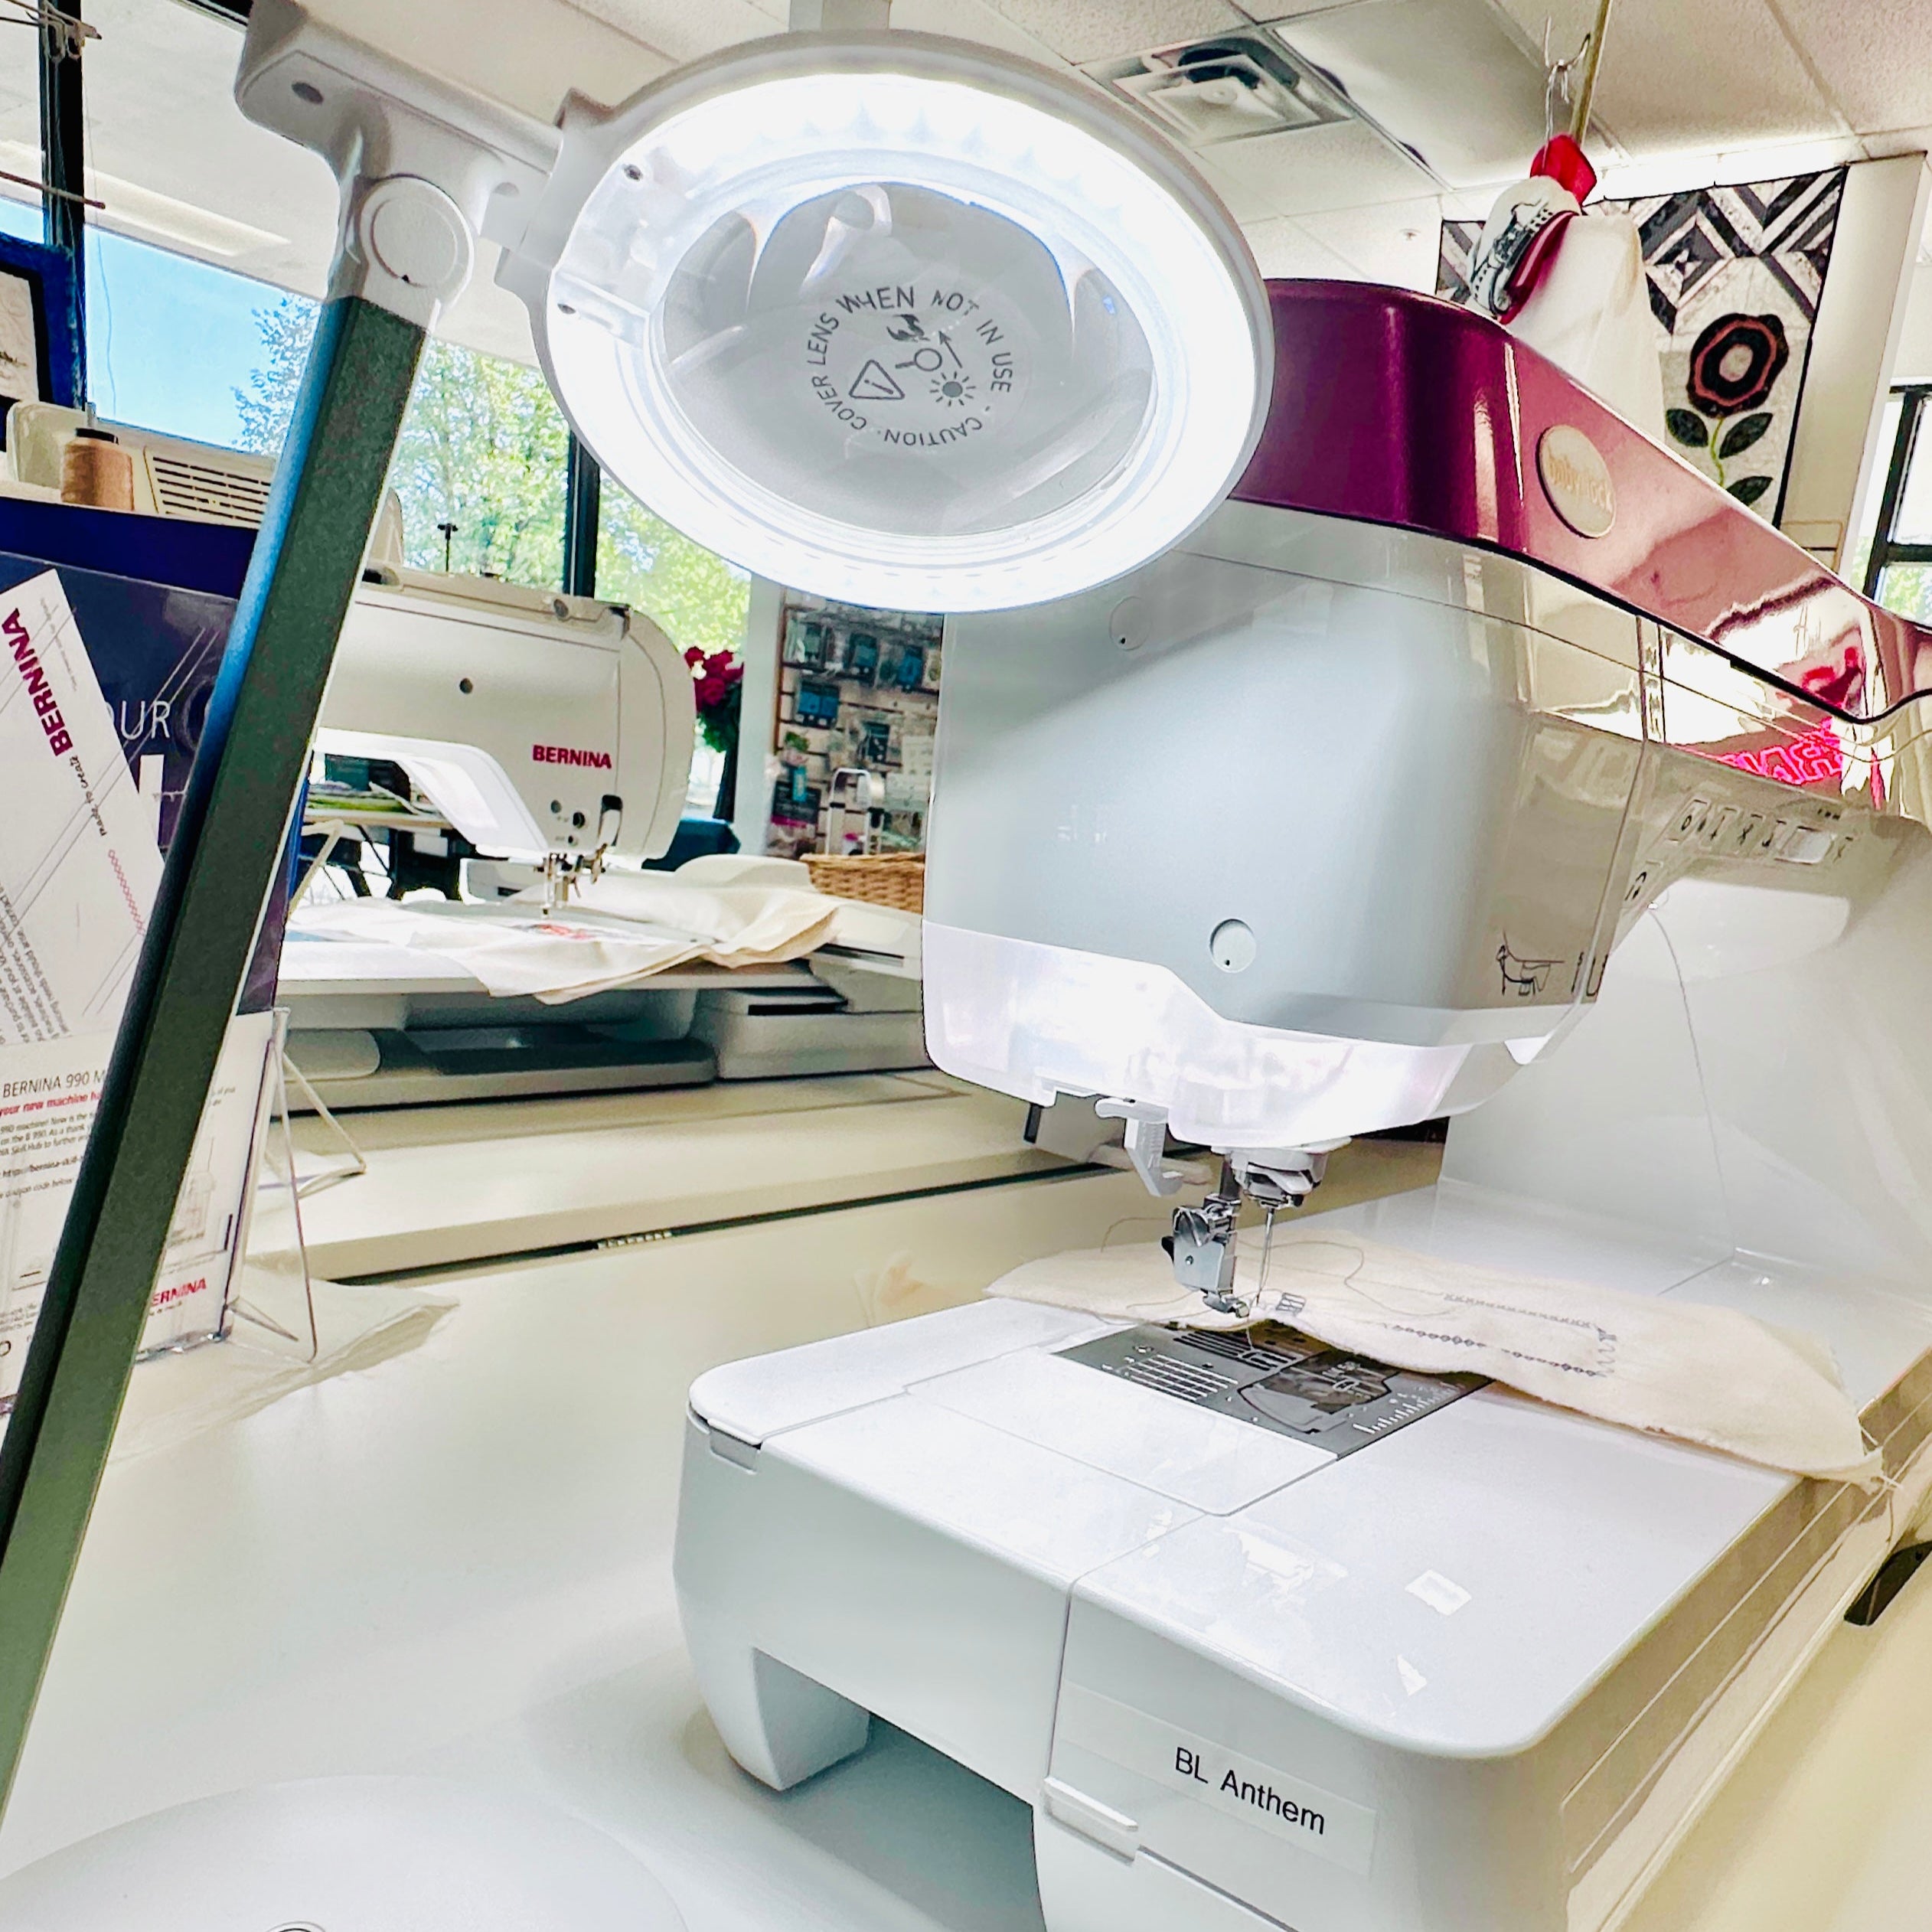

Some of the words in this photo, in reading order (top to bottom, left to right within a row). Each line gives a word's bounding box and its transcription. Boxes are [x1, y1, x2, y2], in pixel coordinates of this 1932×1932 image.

[836, 286, 914, 314] WHEN
[932, 289, 979, 316] NOT
[808, 312, 839, 365] LENS
[976, 319, 1004, 345] IN
[990, 352, 1013, 393] USE
[811, 375, 867, 430] COVER
[884, 416, 982, 445] CAUTION
[2, 608, 73, 756] BERNINA
[106, 700, 170, 740] UR
[533, 744, 612, 770] BERNINA
[70, 756, 88, 788] create
[84, 791, 94, 804] to
[91, 805, 107, 836] made
[3, 1076, 60, 1098] BERNINA
[67, 1071, 90, 1088] 990
[23, 1101, 44, 1111] new
[47, 1095, 88, 1107] machine
[151, 1276, 207, 1305] ERNINA
[1176, 1747, 1208, 1784] BL
[1220, 1770, 1324, 1835] Anthem
